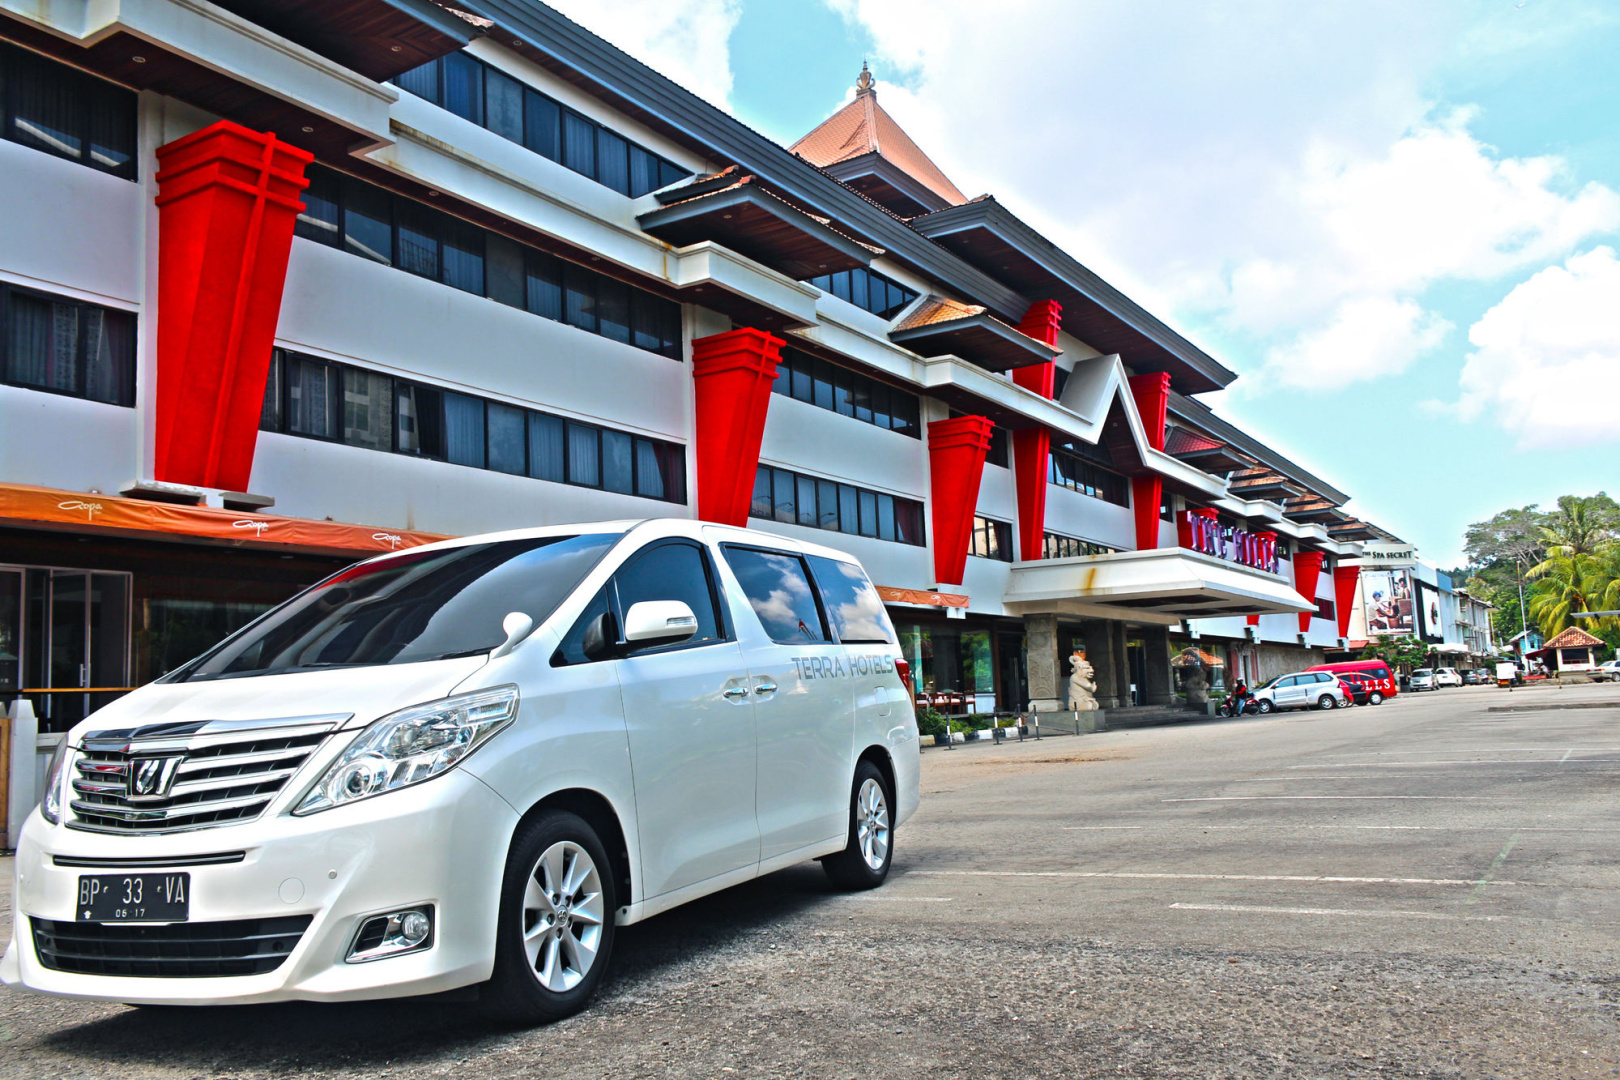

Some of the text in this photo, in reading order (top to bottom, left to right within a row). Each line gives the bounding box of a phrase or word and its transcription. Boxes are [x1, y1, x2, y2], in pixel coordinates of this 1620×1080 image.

[1372, 551, 1385, 559] SPA
[1386, 550, 1412, 559] SECRET
[790, 654, 894, 680] TERRA HOTELS
[80, 876, 185, 906] BP 33 VA
